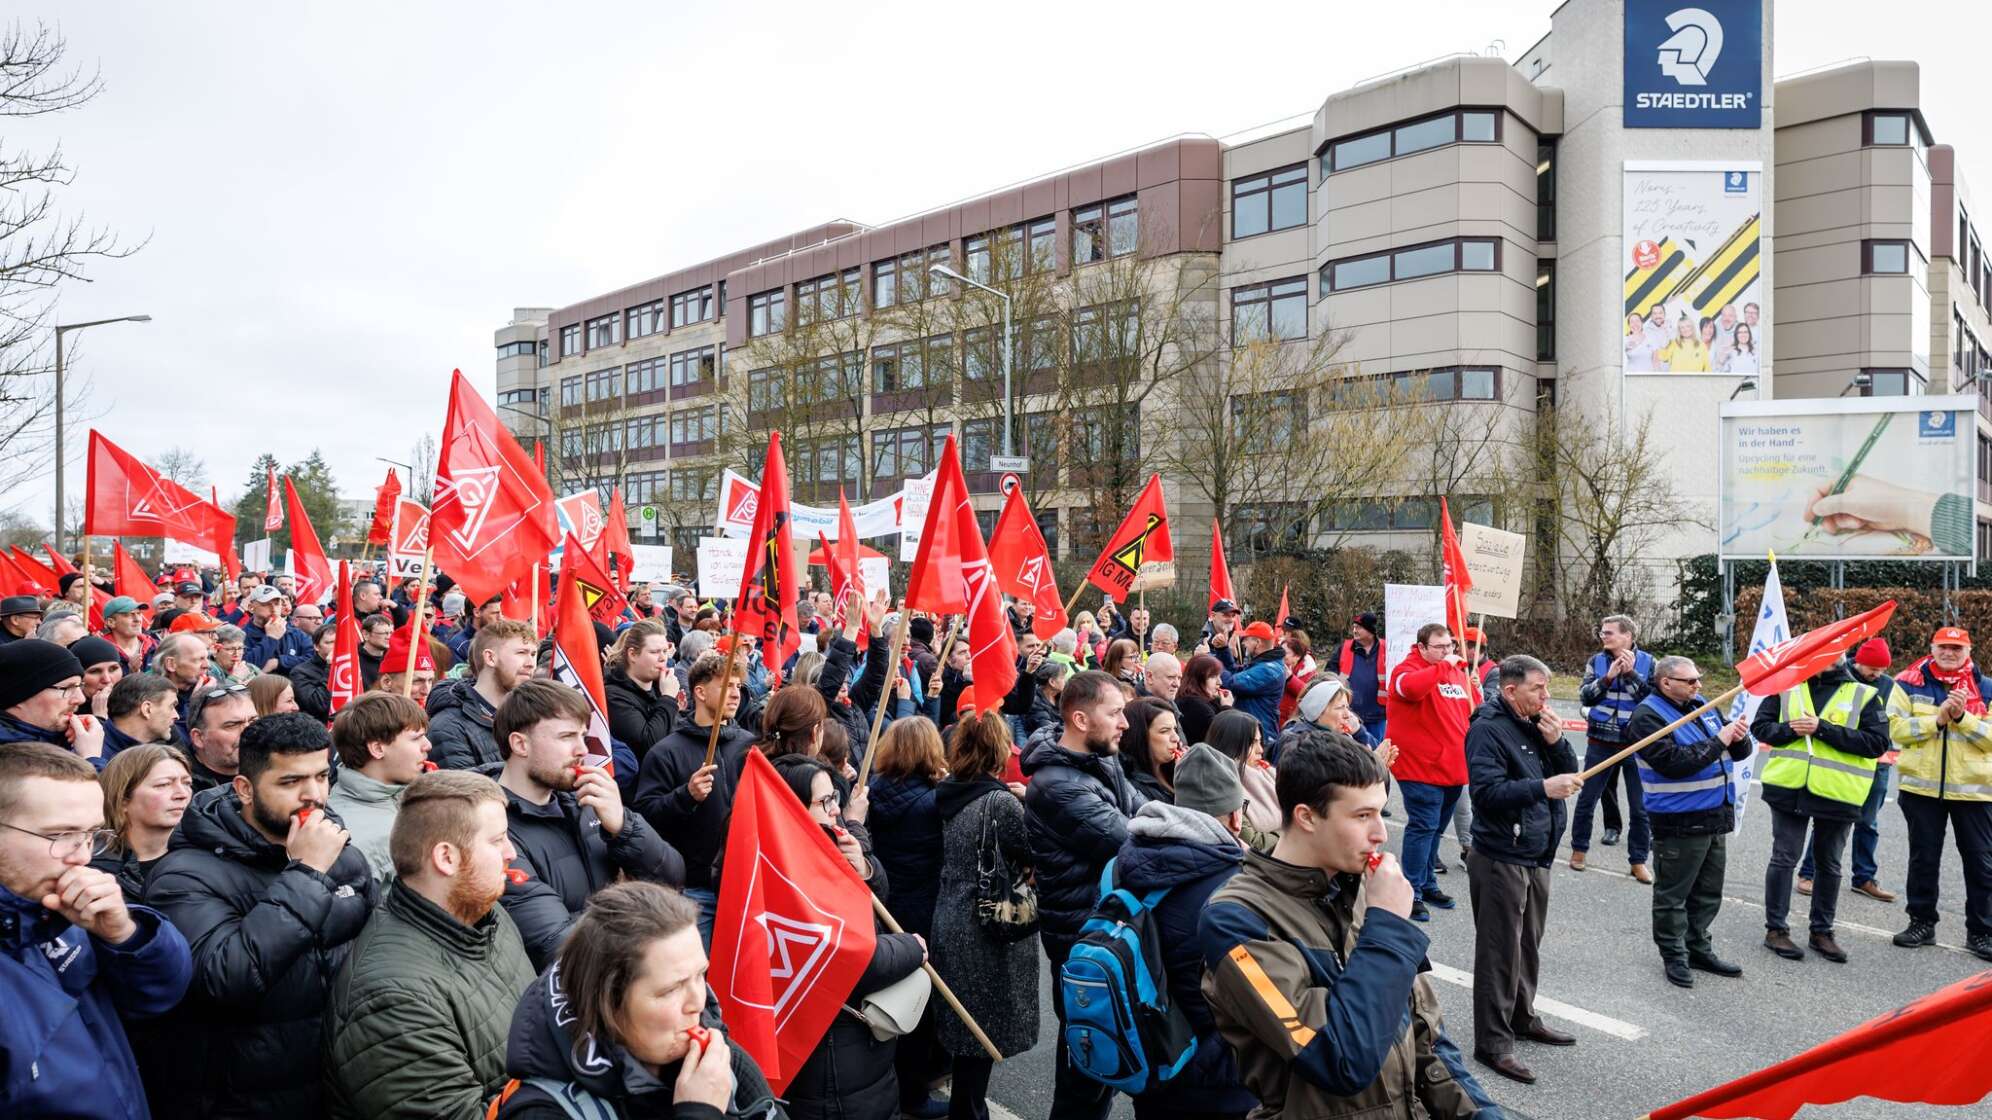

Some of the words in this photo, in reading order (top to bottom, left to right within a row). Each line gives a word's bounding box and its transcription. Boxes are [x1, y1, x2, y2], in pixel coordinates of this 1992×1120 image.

[1636, 92, 1747, 109] STAEDTLER
[1738, 427, 1755, 435] Wir
[1758, 426, 1788, 435] haben
[1790, 427, 1801, 435] es
[1738, 440, 1748, 448] in
[1750, 439, 1766, 448] der
[1769, 439, 1795, 448] Hand
[1738, 454, 1780, 465] Upcycling
[1798, 453, 1817, 461] eine
[1098, 559, 1116, 577] IG
